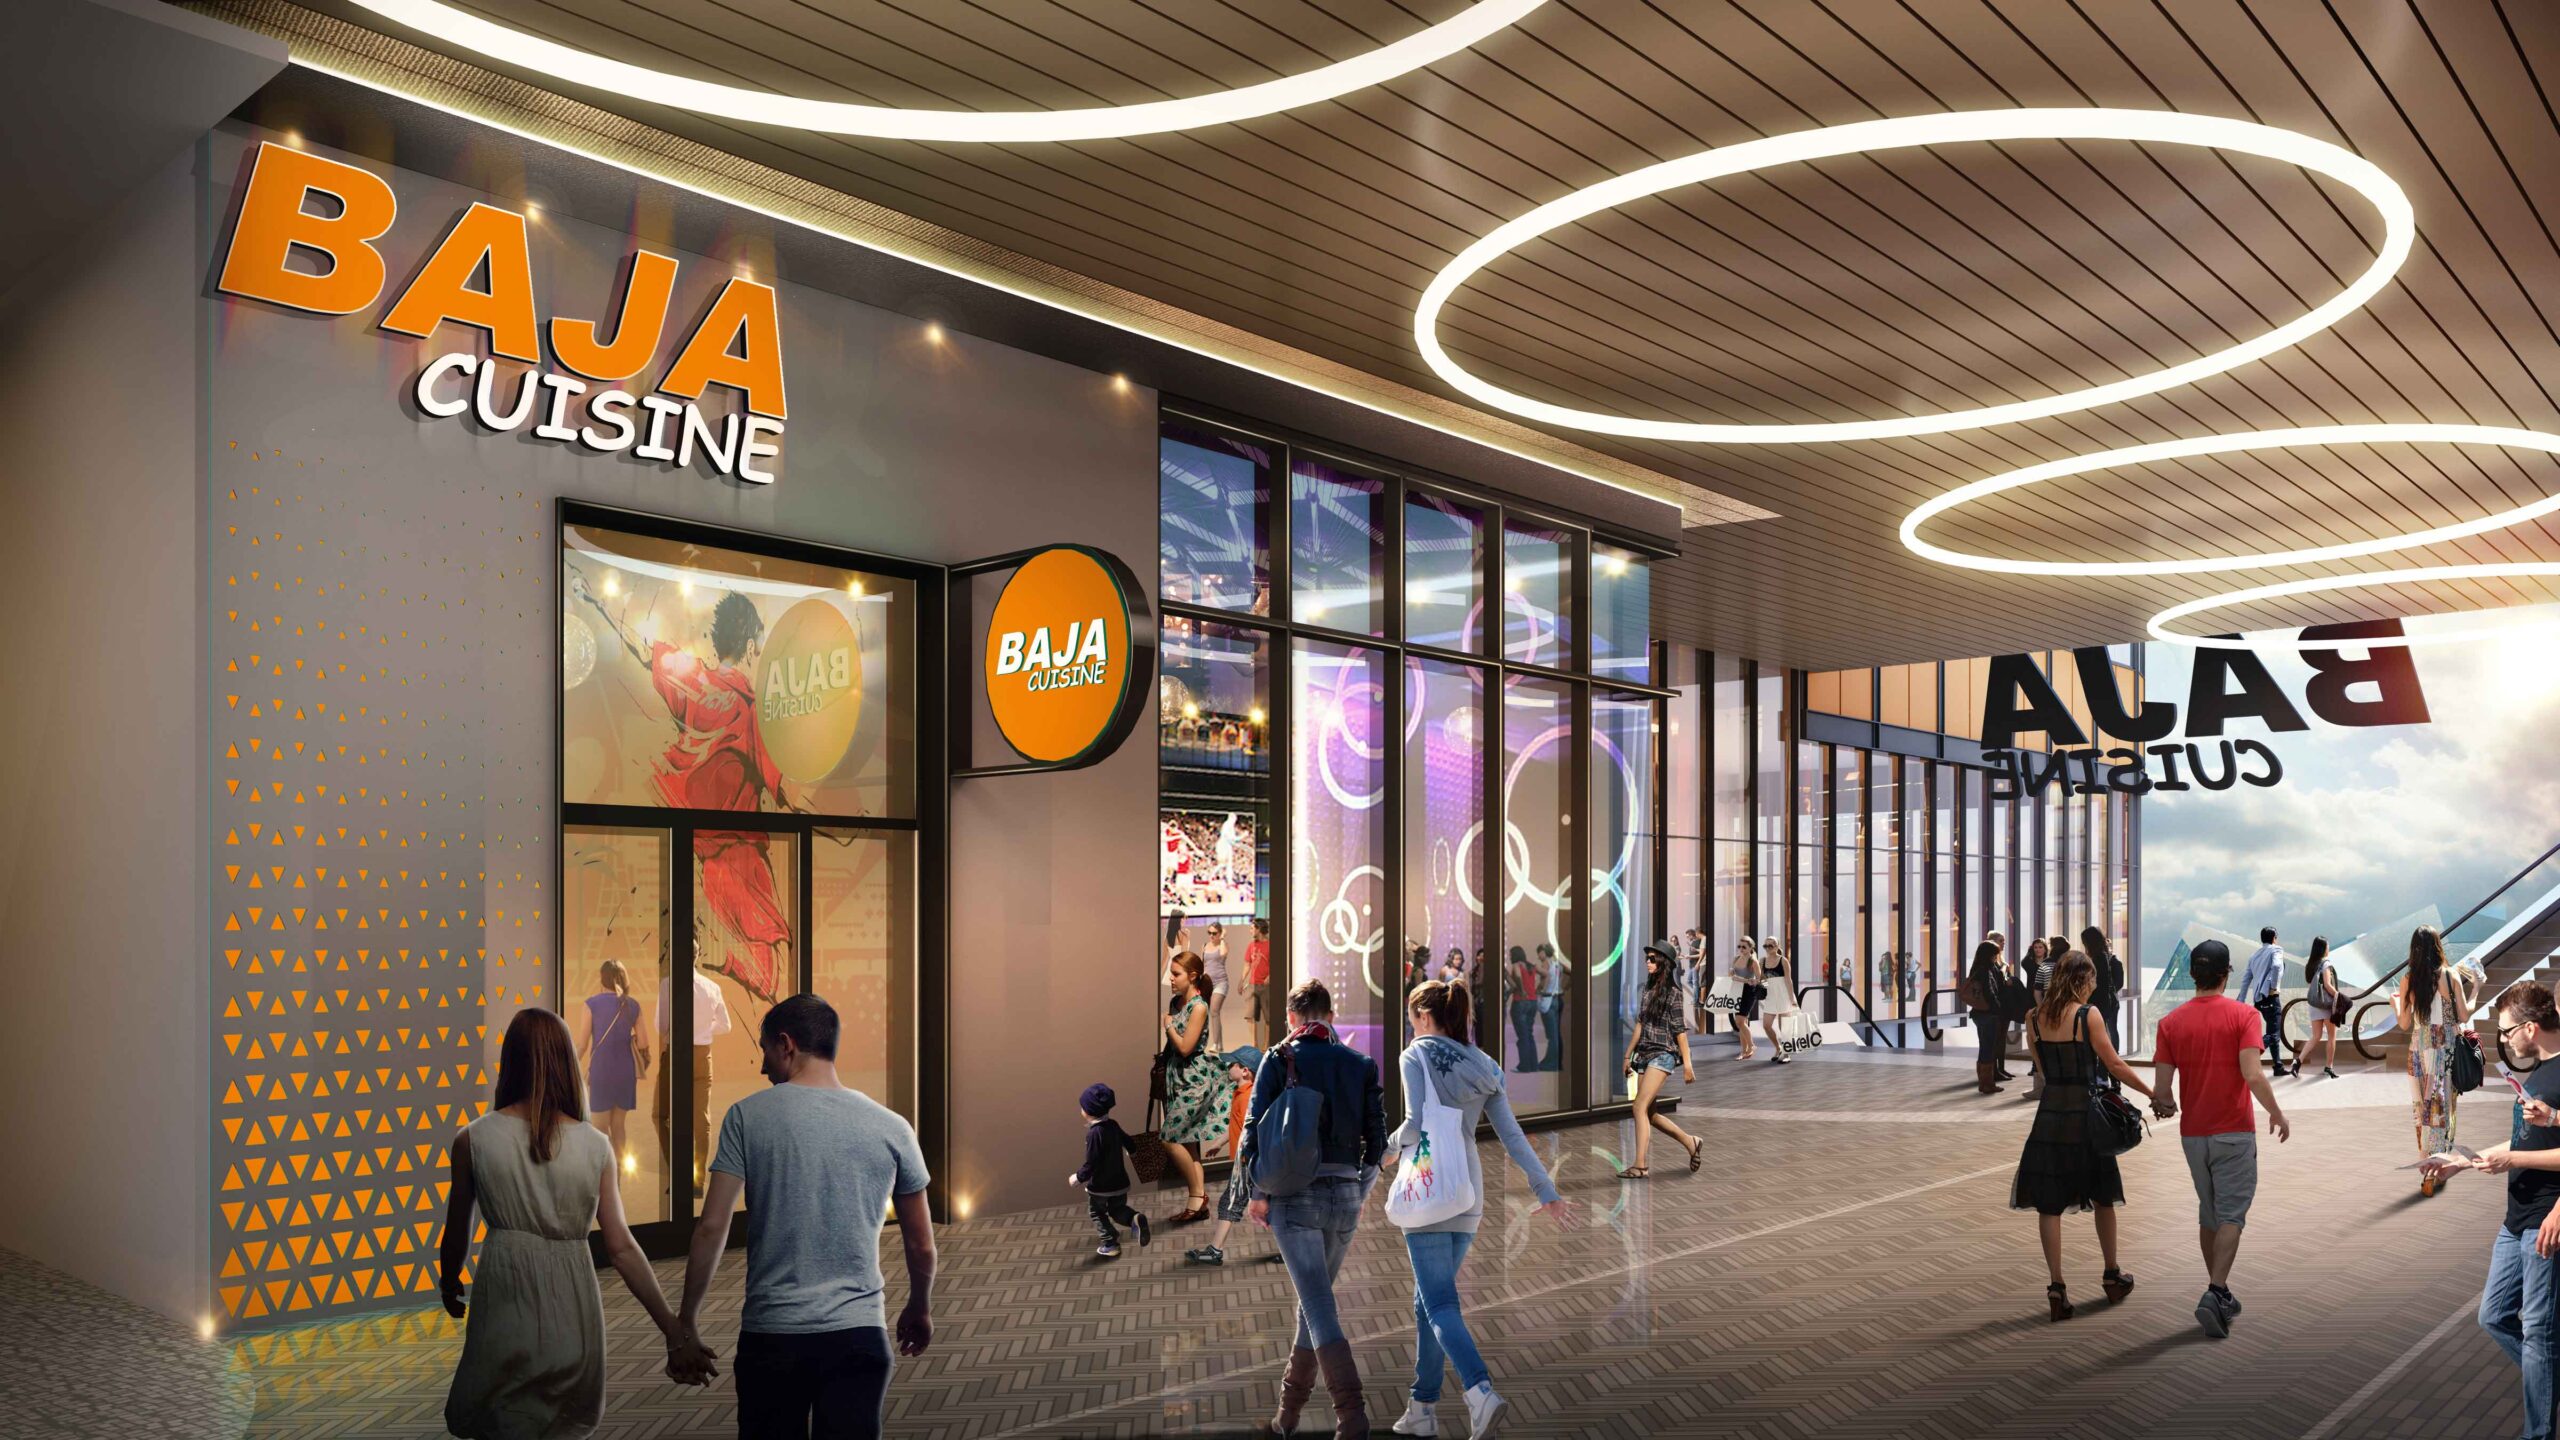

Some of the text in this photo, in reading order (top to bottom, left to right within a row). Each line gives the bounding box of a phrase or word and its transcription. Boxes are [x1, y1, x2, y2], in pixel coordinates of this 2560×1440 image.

[216, 140, 788, 420] BAJA
[415, 352, 785, 484] CUISINE
[996, 618, 1108, 676] BAJA
[1027, 660, 1108, 692] CUISINE
